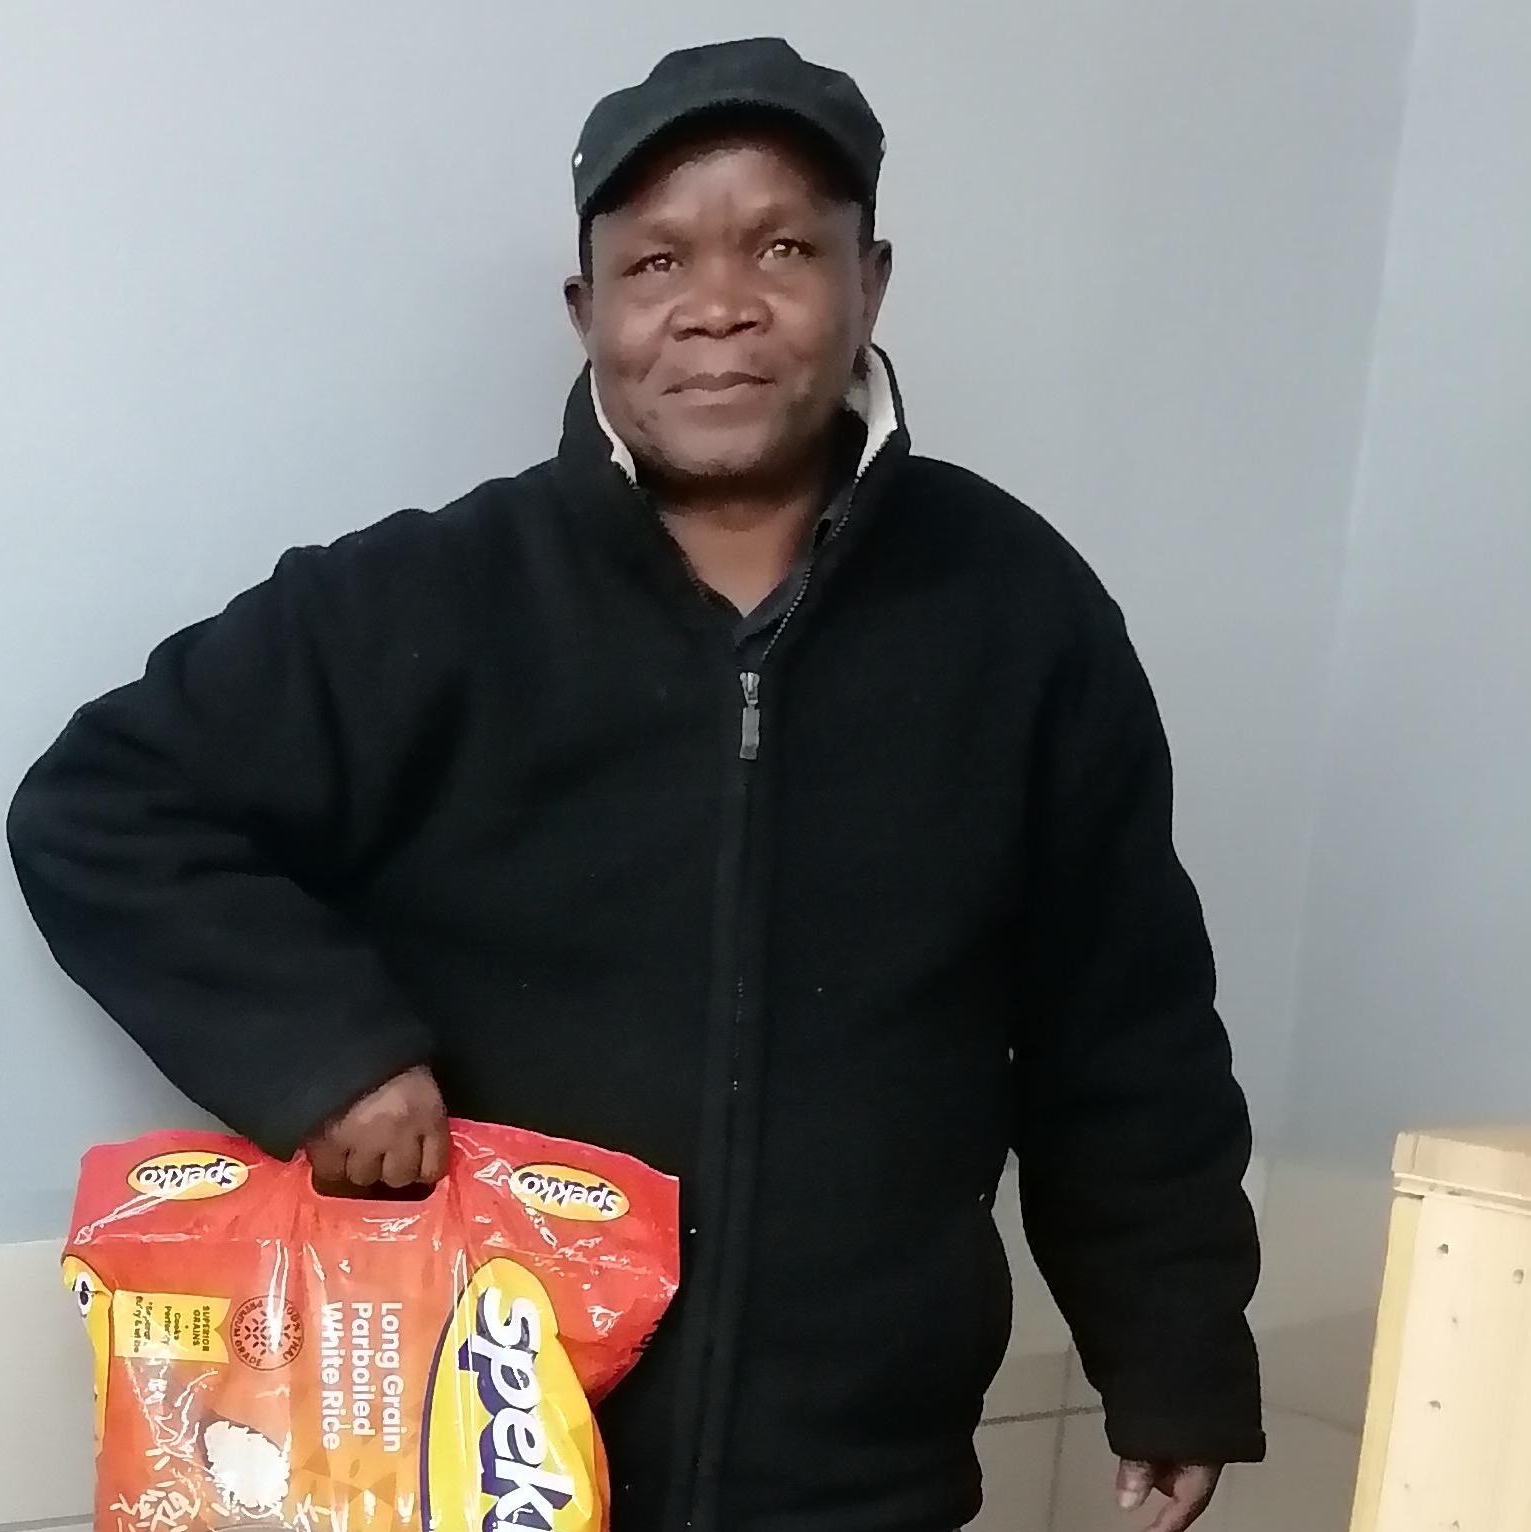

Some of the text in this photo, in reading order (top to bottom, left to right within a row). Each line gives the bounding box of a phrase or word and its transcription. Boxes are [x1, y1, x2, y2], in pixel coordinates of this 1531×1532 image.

[192, 1309, 202, 1346] GRAINS
[202, 1305, 211, 1352] SUPERIOR
[321, 1301, 347, 1451] White Rice
[351, 1302, 377, 1436] Parboiled
[375, 1302, 408, 1452] Long Grain
